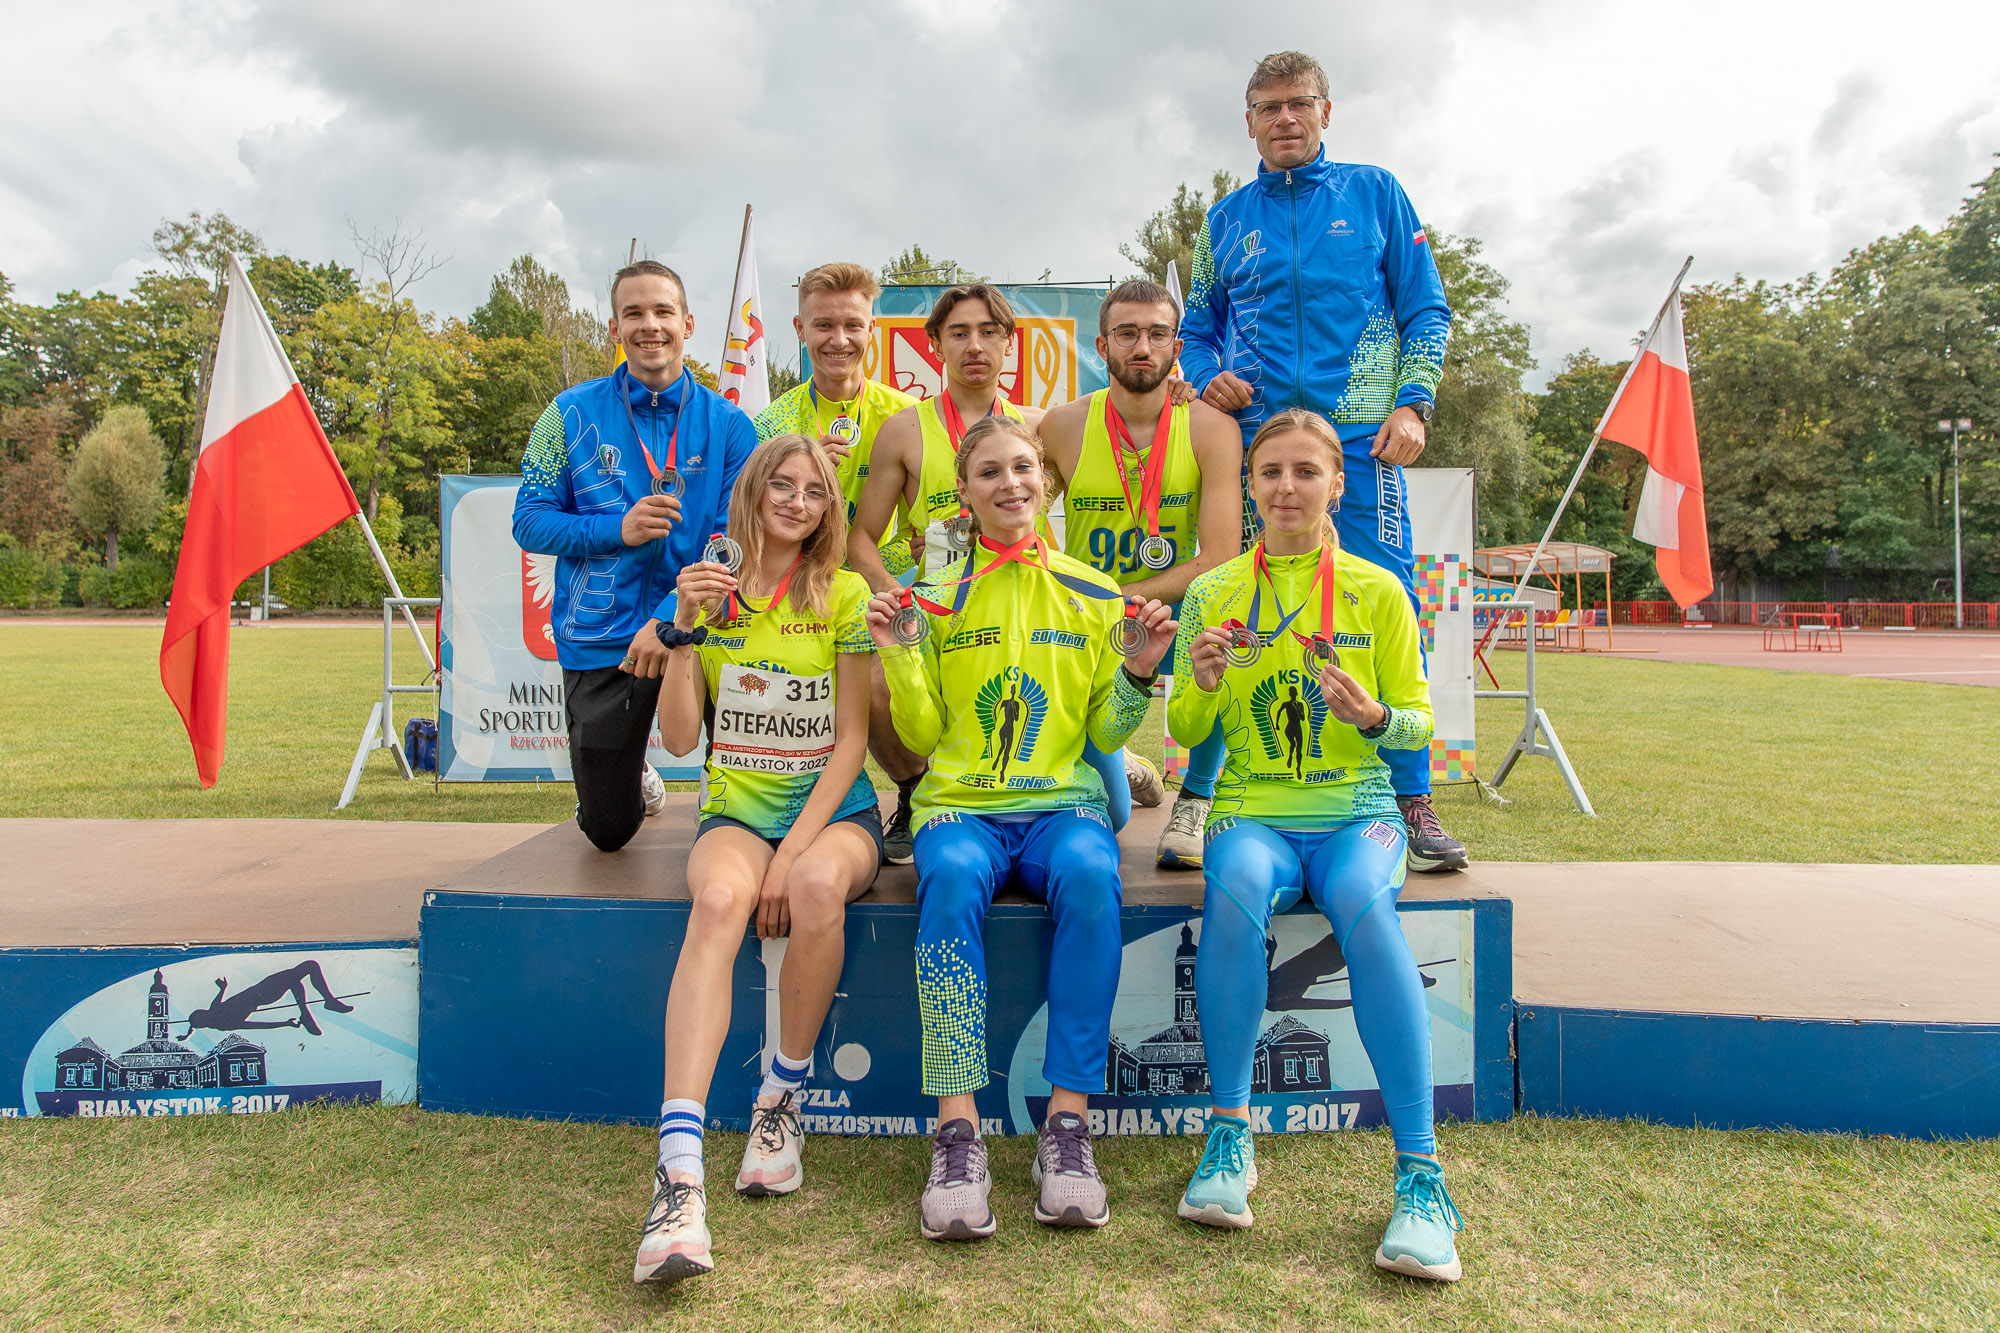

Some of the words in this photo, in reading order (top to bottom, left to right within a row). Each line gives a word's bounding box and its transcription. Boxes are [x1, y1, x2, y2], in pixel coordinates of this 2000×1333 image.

[1089, 526, 1177, 574] 995
[781, 622, 829, 635] KGHM
[1003, 666, 1019, 682] KS
[1278, 669, 1300, 684] KS
[508, 681, 563, 704] MINI
[786, 676, 830, 702] 315
[479, 708, 561, 732] SPORTU
[720, 709, 832, 738] STEFAŃSKA
[510, 735, 569, 748] RZECZYPO
[733, 745, 775, 755] MISTRZOSTWA
[721, 754, 795, 772] BIAŁYSTOK
[799, 756, 829, 771] 2022
[232, 1094, 290, 1114] 2017
[800, 1115, 914, 1134] TRZOSTWA
[1088, 1105, 1273, 1136] BIAŁYSK
[1286, 1102, 1361, 1132] 2017
